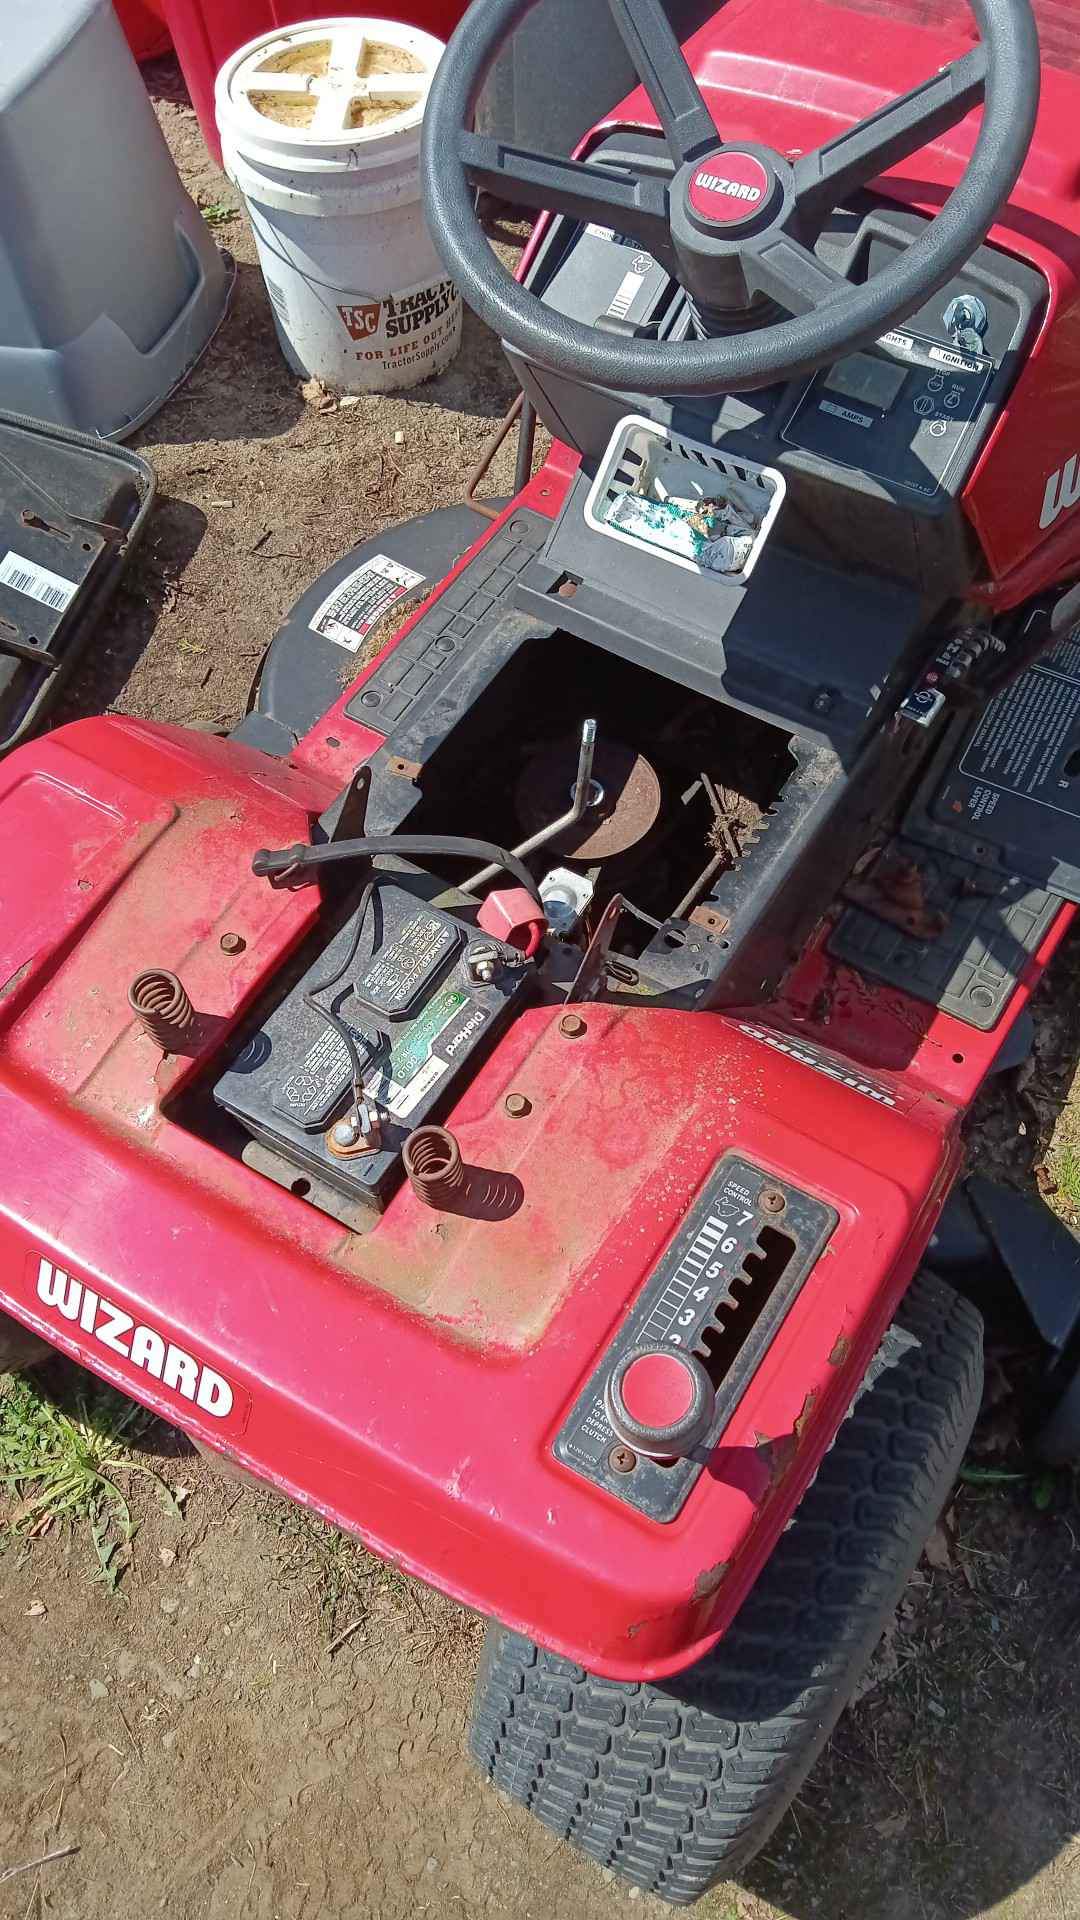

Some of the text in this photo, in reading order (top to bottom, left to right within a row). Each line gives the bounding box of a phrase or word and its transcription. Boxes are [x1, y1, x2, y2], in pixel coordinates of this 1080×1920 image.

[695, 173, 761, 202] WIZARD
[341, 306, 377, 333] TSC
[386, 286, 449, 338] SUPPLY
[356, 350, 384, 361] FOR
[390, 340, 418, 358] LIFE
[423, 327, 442, 345] OUT
[942, 353, 979, 371] IGNITION
[842, 410, 864, 425] AMPS
[1058, 779, 1070, 789] R
[421, 938, 445, 968] DANGER
[395, 974, 419, 1001] POISON
[445, 1011, 486, 1056] DieHard
[397, 1055, 418, 1079] GOLD
[723, 1187, 752, 1207] CONTROL
[727, 1180, 750, 1197] SPEED
[736, 1210, 754, 1227] 7
[720, 1237, 738, 1254] 6
[705, 1261, 724, 1279] 5
[692, 1285, 710, 1302] 4
[678, 1308, 696, 1327] 3
[36, 1257, 234, 1418] WIZARD
[591, 1408, 601, 1418] TO
[581, 1424, 607, 1443] CLUTCH
[586, 1416, 614, 1437] DEPRESS
